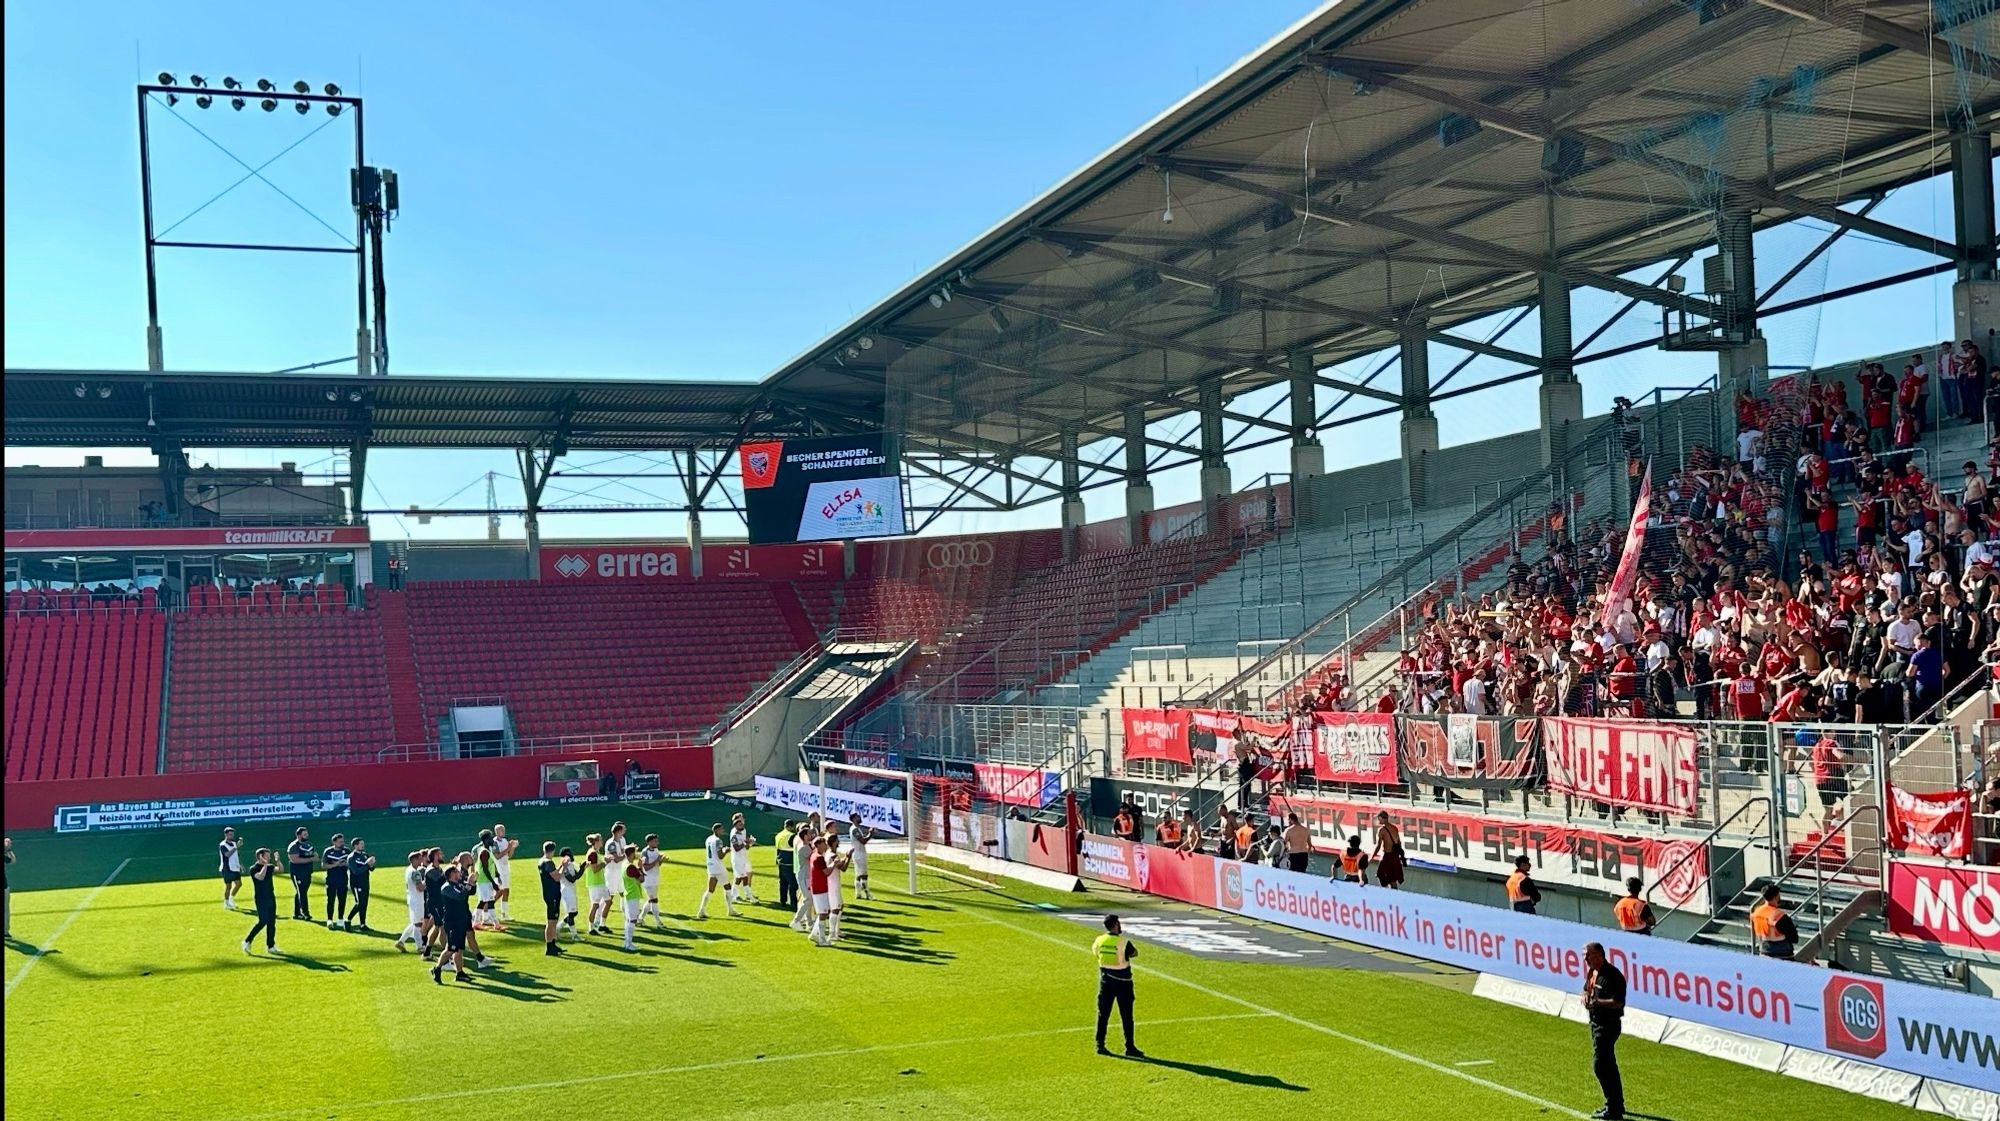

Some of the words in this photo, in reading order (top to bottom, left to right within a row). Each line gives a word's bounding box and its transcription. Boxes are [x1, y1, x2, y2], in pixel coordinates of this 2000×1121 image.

[786, 451, 823, 463] BECHER
[801, 460, 852, 471] SCHANZEN
[853, 456, 886, 466] GEBEN
[822, 487, 862, 519] ELISA
[1619, 730, 1696, 810] FANS
[100, 803, 117, 812] Aus
[118, 802, 149, 812] Bayern
[150, 801, 163, 810] für
[165, 800, 195, 809] Bayern
[410, 806, 438, 814] energy
[460, 801, 503, 810] electronics
[522, 799, 549, 807] energy
[99, 813, 133, 823] Heizöle
[134, 812, 151, 821] und
[154, 810, 201, 821] Kraftstoffe
[203, 807, 229, 816] direkt
[252, 805, 295, 814] Hersteller
[1356, 811, 1469, 859] FSSEN
[1483, 826, 1547, 869] SEIT
[1566, 834, 1644, 882] 1907
[1227, 872, 1240, 893] RGS
[1254, 878, 1409, 940] Gebäudetechnik
[1415, 909, 1436, 946] in
[1442, 917, 1506, 960] einer
[1514, 938, 1588, 979] neue
[1609, 946, 1792, 1025] Dimension
[1843, 996, 1878, 1030] RGS
[1703, 1034, 1762, 1062] energy
[1808, 1059, 1910, 1100] electronics
